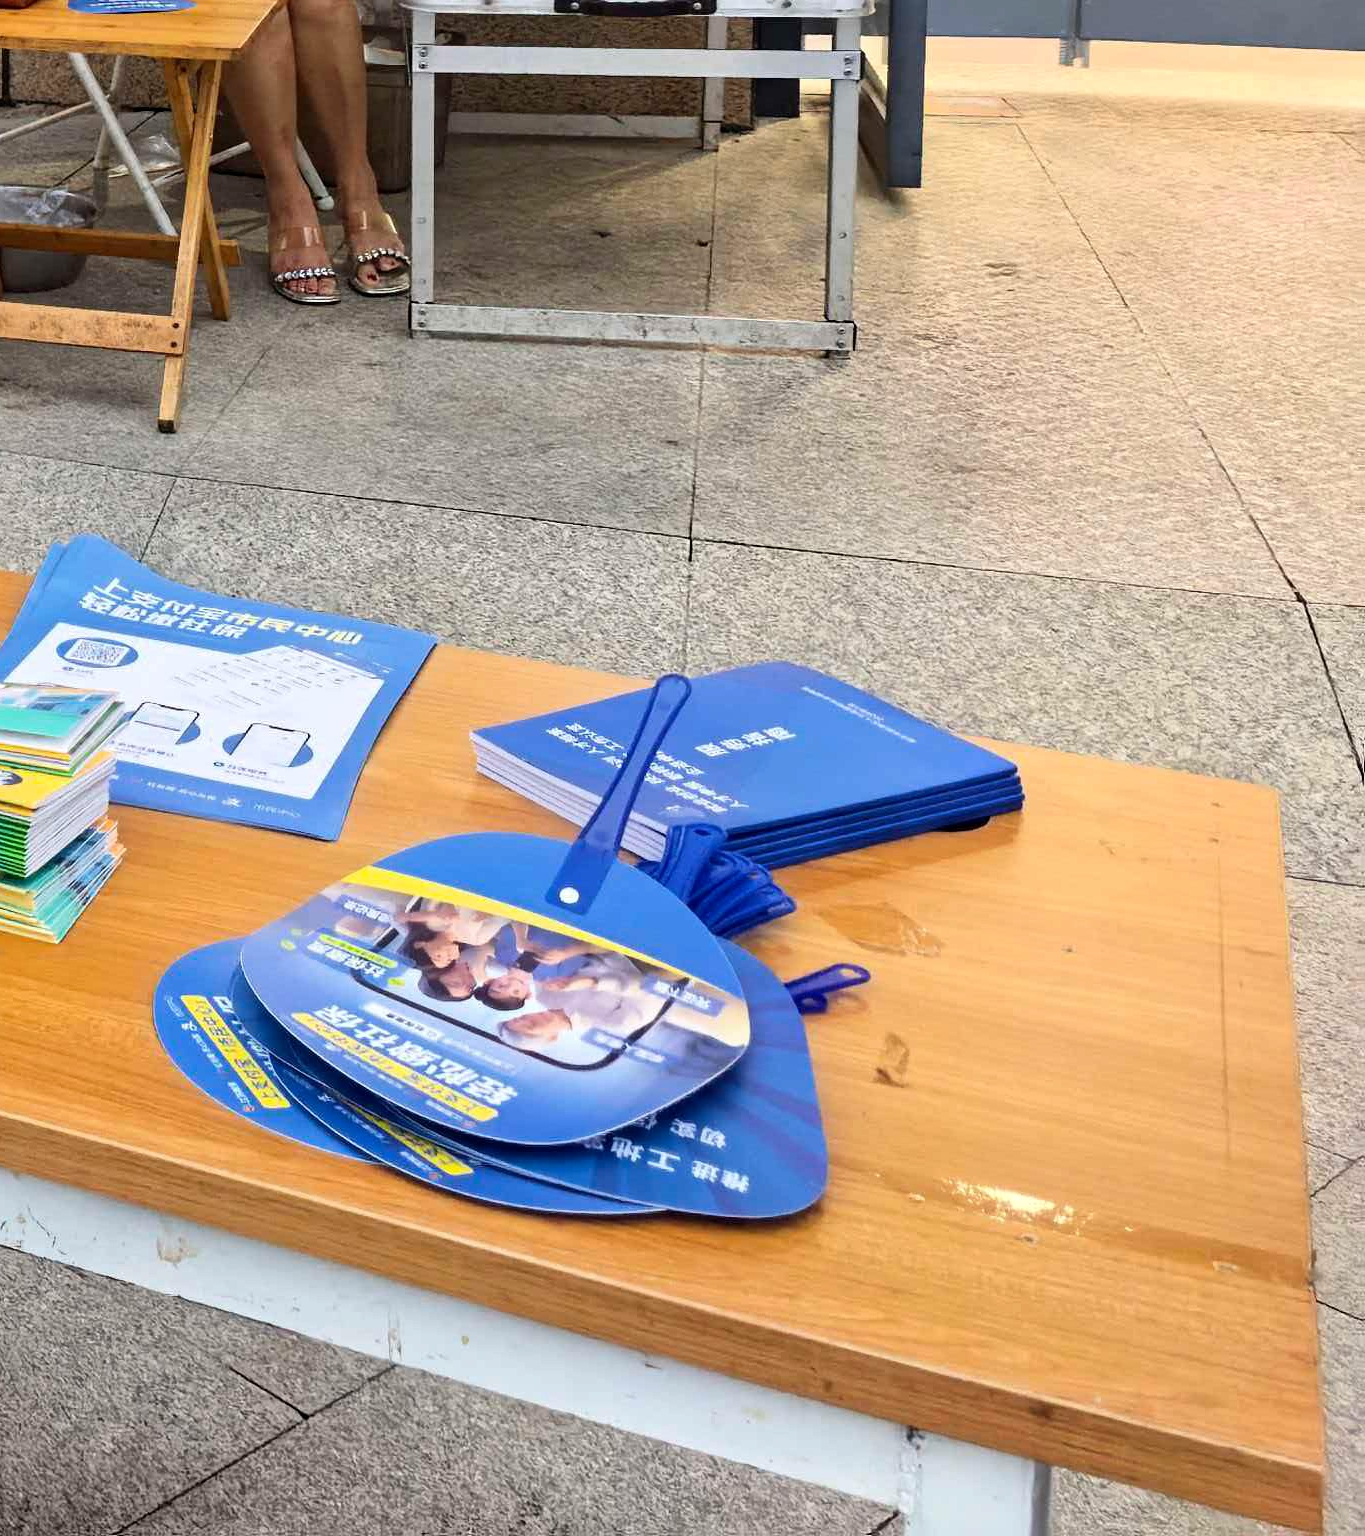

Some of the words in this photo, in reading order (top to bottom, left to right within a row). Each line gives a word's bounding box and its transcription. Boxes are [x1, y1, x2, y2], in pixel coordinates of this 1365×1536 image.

[76, 591, 250, 641] 轻松缴社保
[93, 576, 364, 646] 上支付宝市民中心
[694, 726, 799, 759] 服务指南
[313, 1002, 519, 1107] 轻松缴社保
